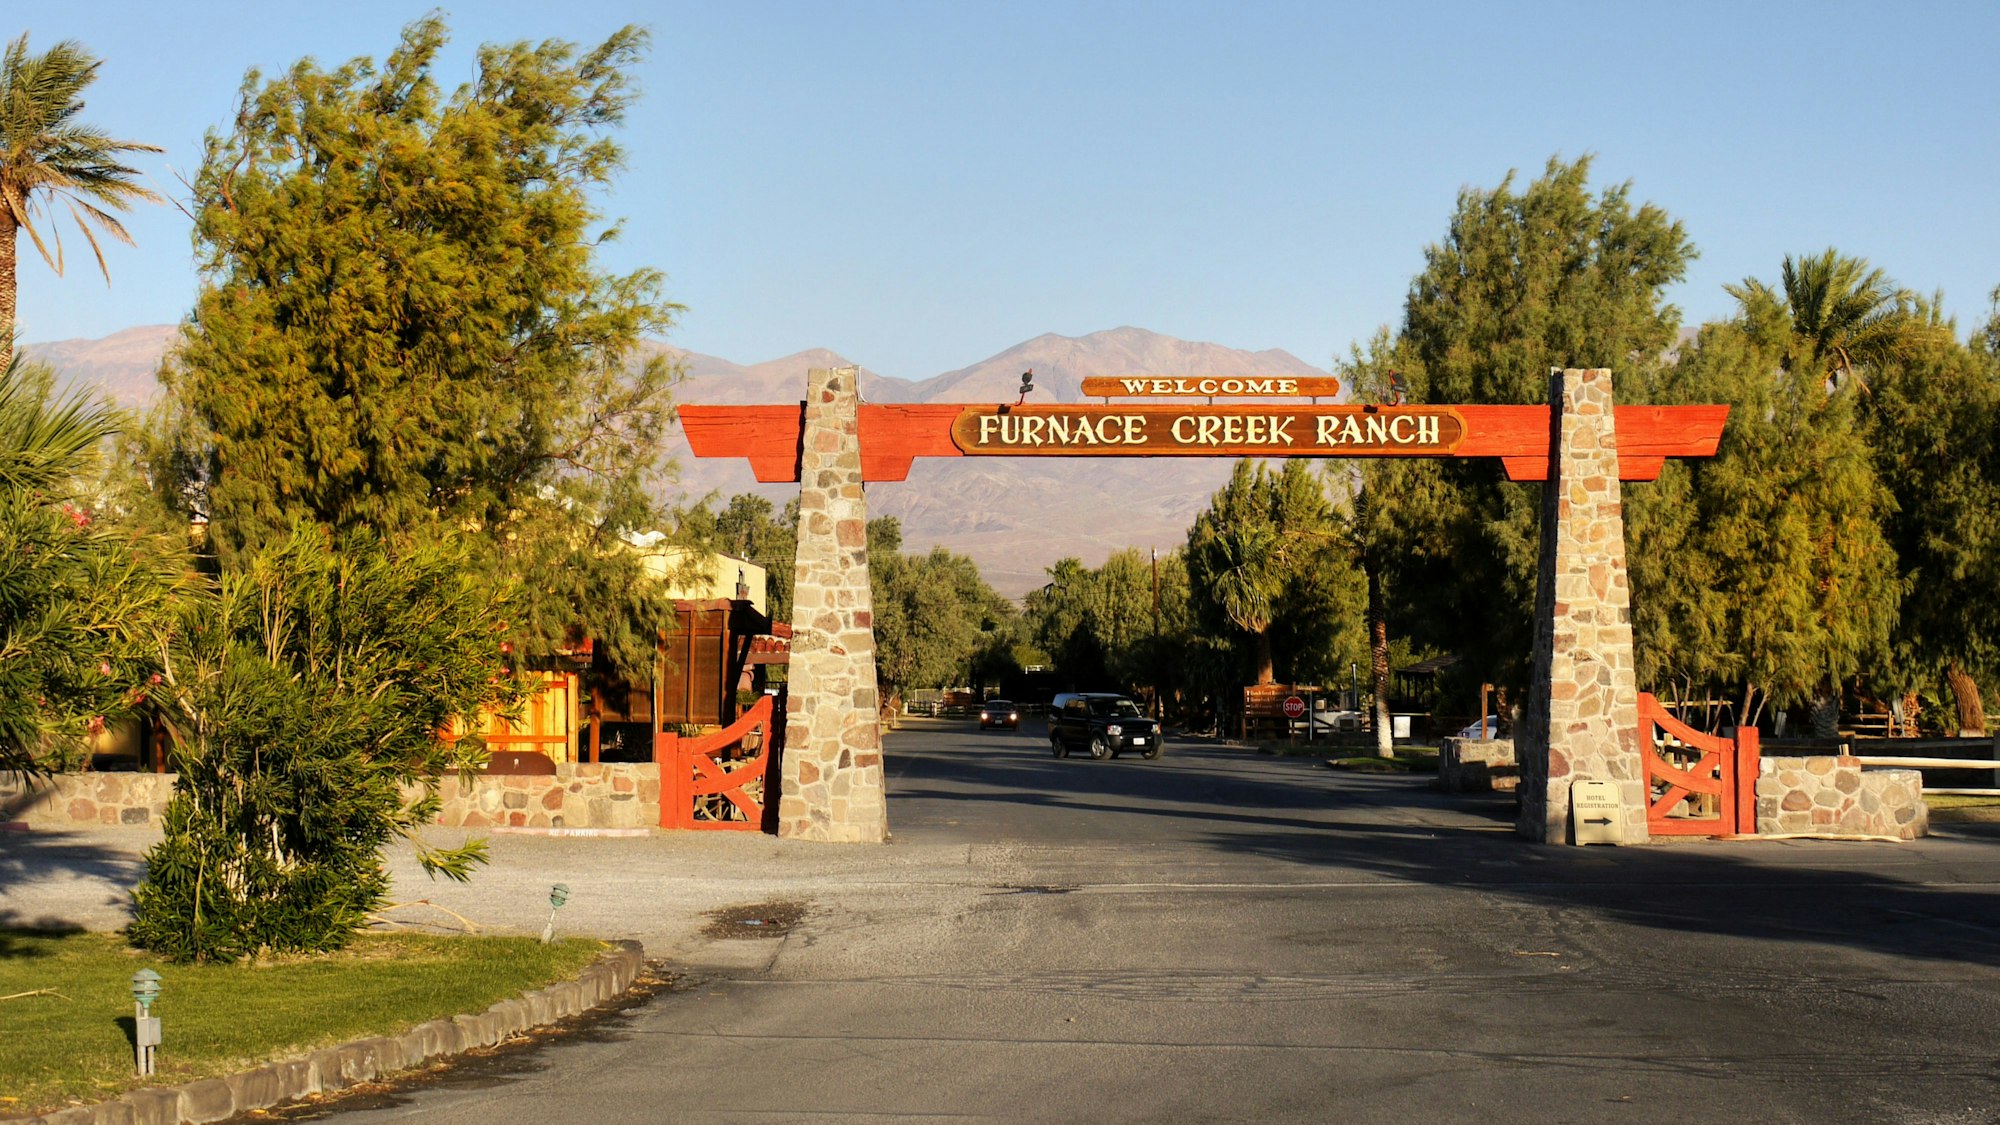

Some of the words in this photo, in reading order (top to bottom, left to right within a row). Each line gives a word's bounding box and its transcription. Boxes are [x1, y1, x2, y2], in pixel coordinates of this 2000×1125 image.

[1120, 379, 1298, 394] WELCOME
[978, 414, 1148, 447] FURNACE
[1171, 415, 1295, 446] CREEK
[1316, 414, 1440, 447] RANCH
[1285, 702, 1303, 711] STOP
[564, 829, 599, 838] PARKING
